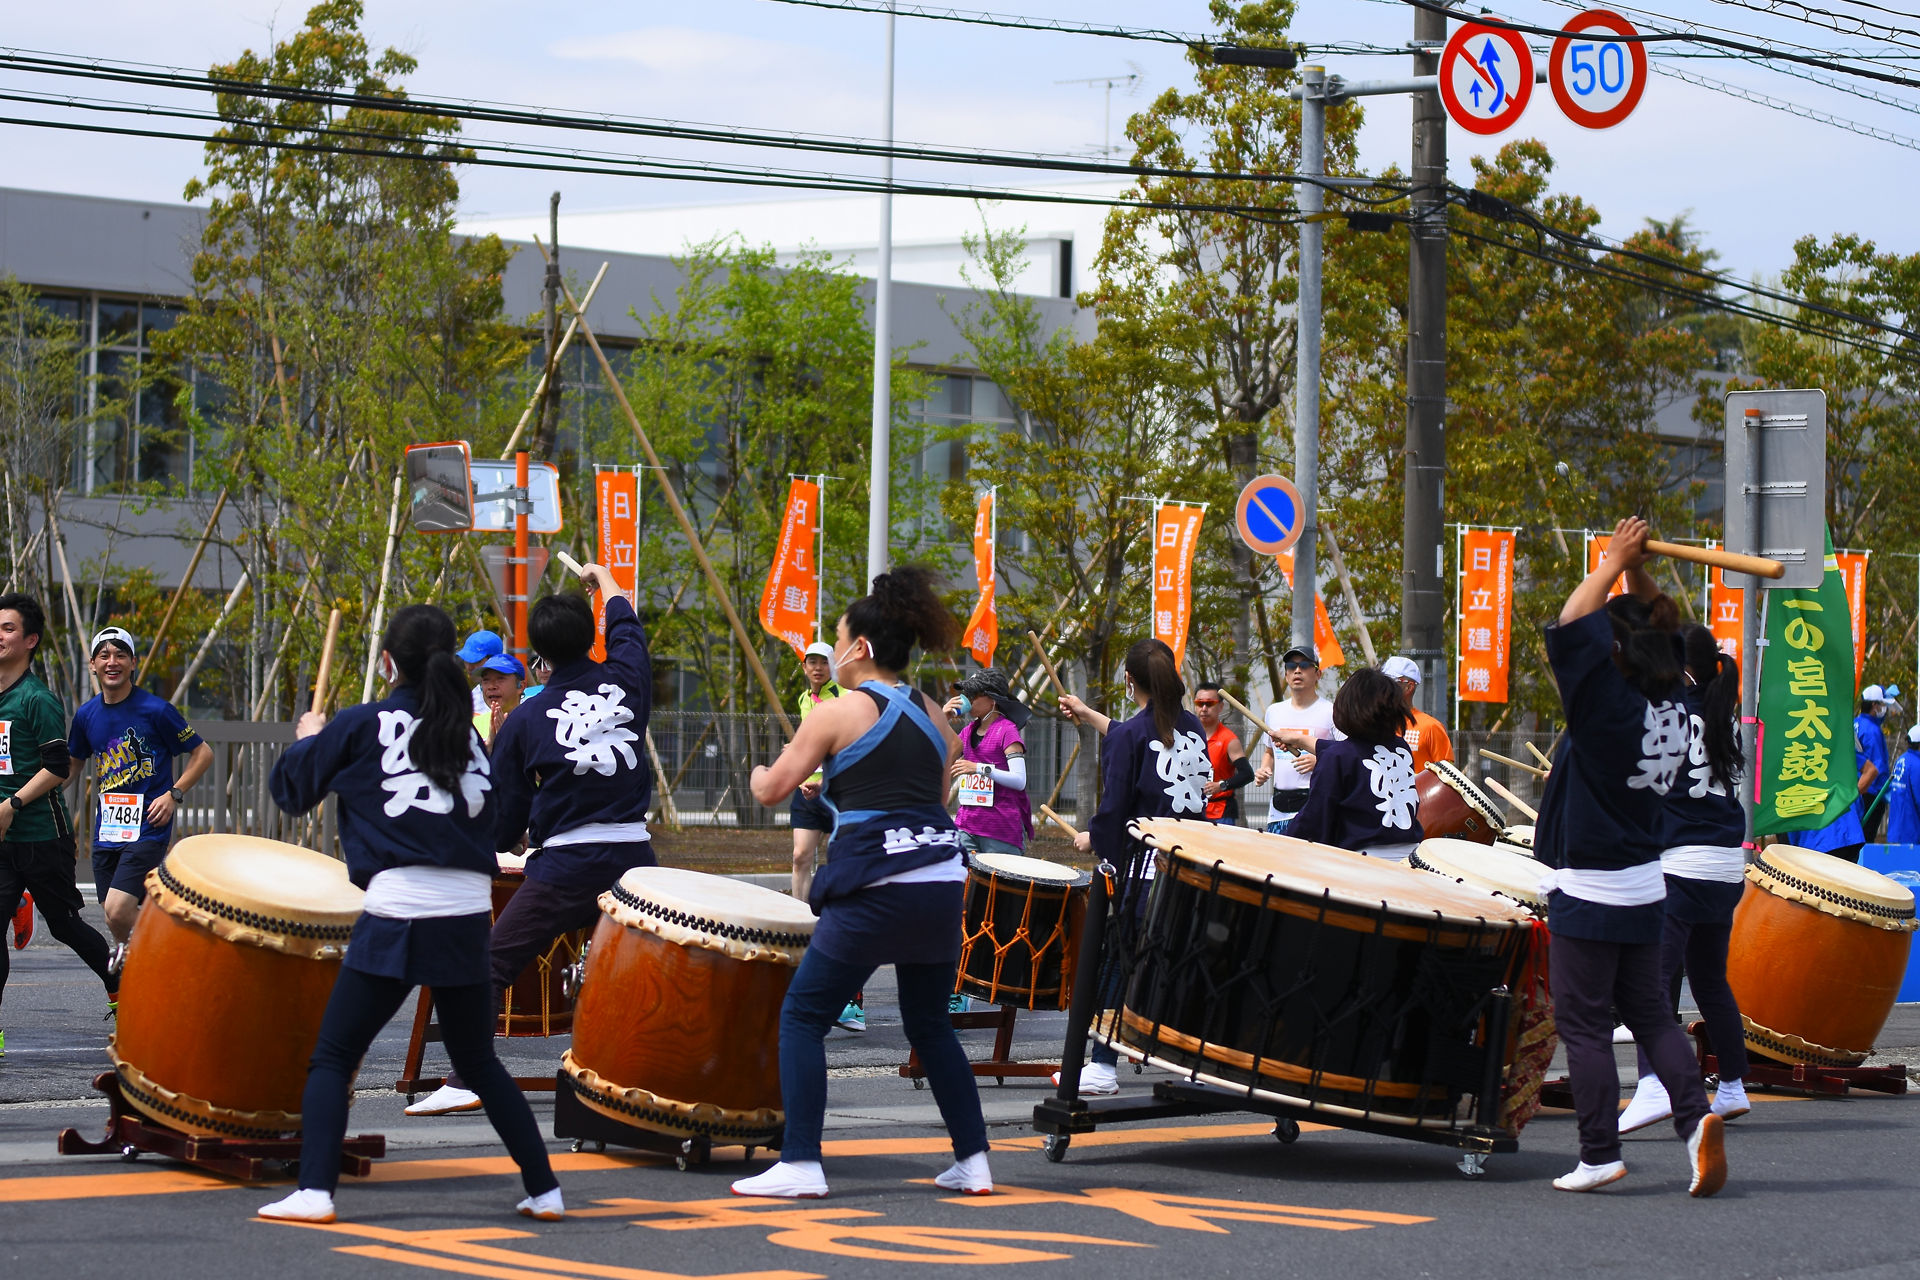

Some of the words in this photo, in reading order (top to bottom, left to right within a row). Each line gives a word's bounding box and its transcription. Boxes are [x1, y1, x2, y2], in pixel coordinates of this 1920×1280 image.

[1571, 43, 1624, 95] 50
[1467, 548, 1492, 692] 日立建機
[966, 774, 993, 790] 10264
[109, 806, 140, 824] 7484
